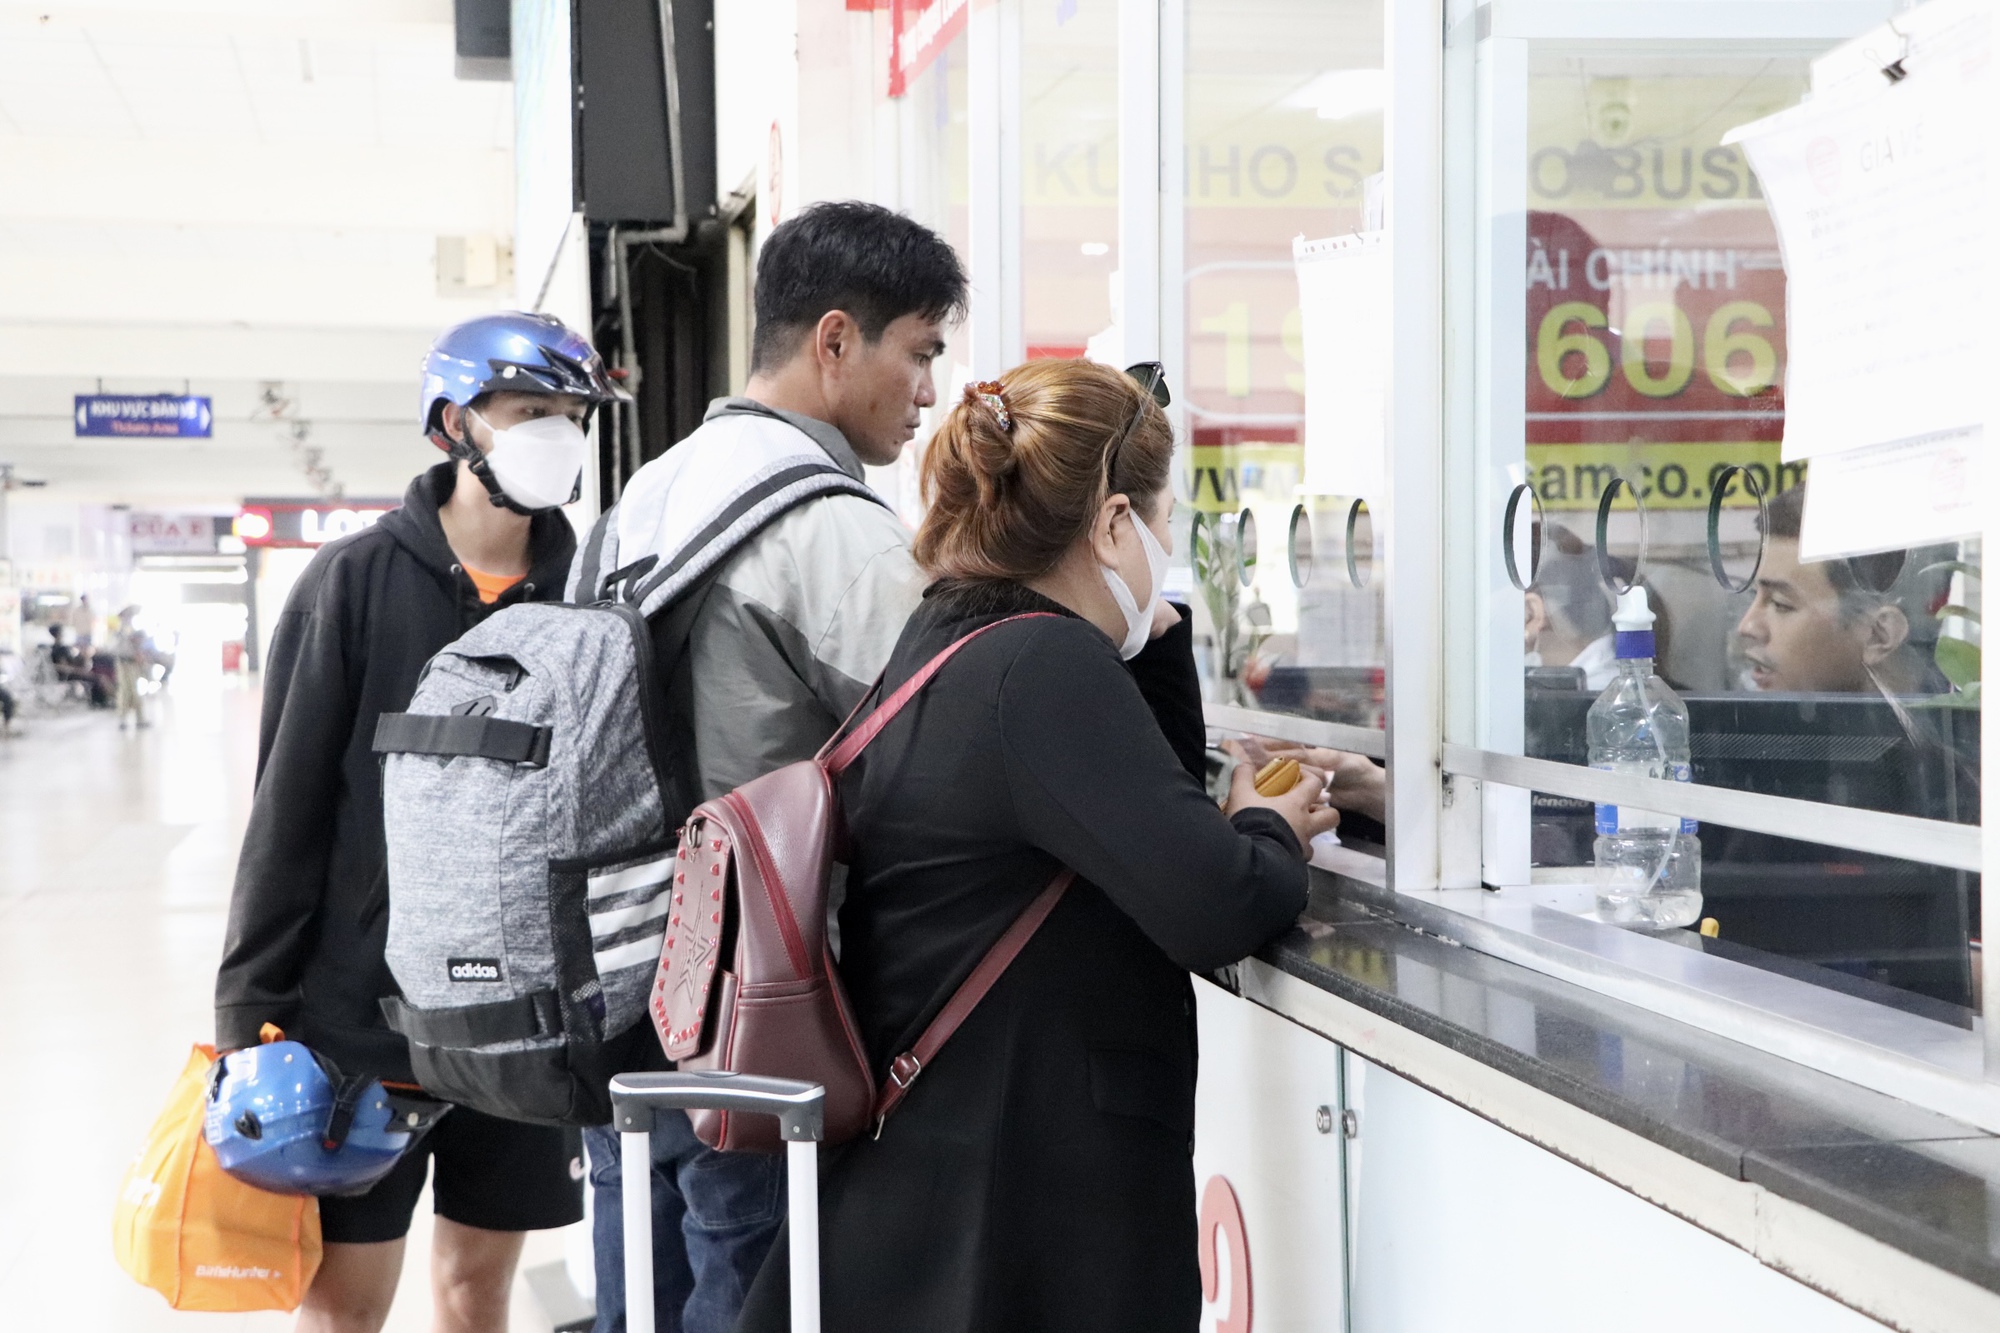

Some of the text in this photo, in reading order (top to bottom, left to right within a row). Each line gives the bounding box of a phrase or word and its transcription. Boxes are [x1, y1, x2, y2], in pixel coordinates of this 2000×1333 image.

[1526, 237, 1569, 291] ÀI
[91, 400, 120, 419] KHU
[1532, 795, 1589, 809] lenovo
[451, 963, 498, 979] adidas
